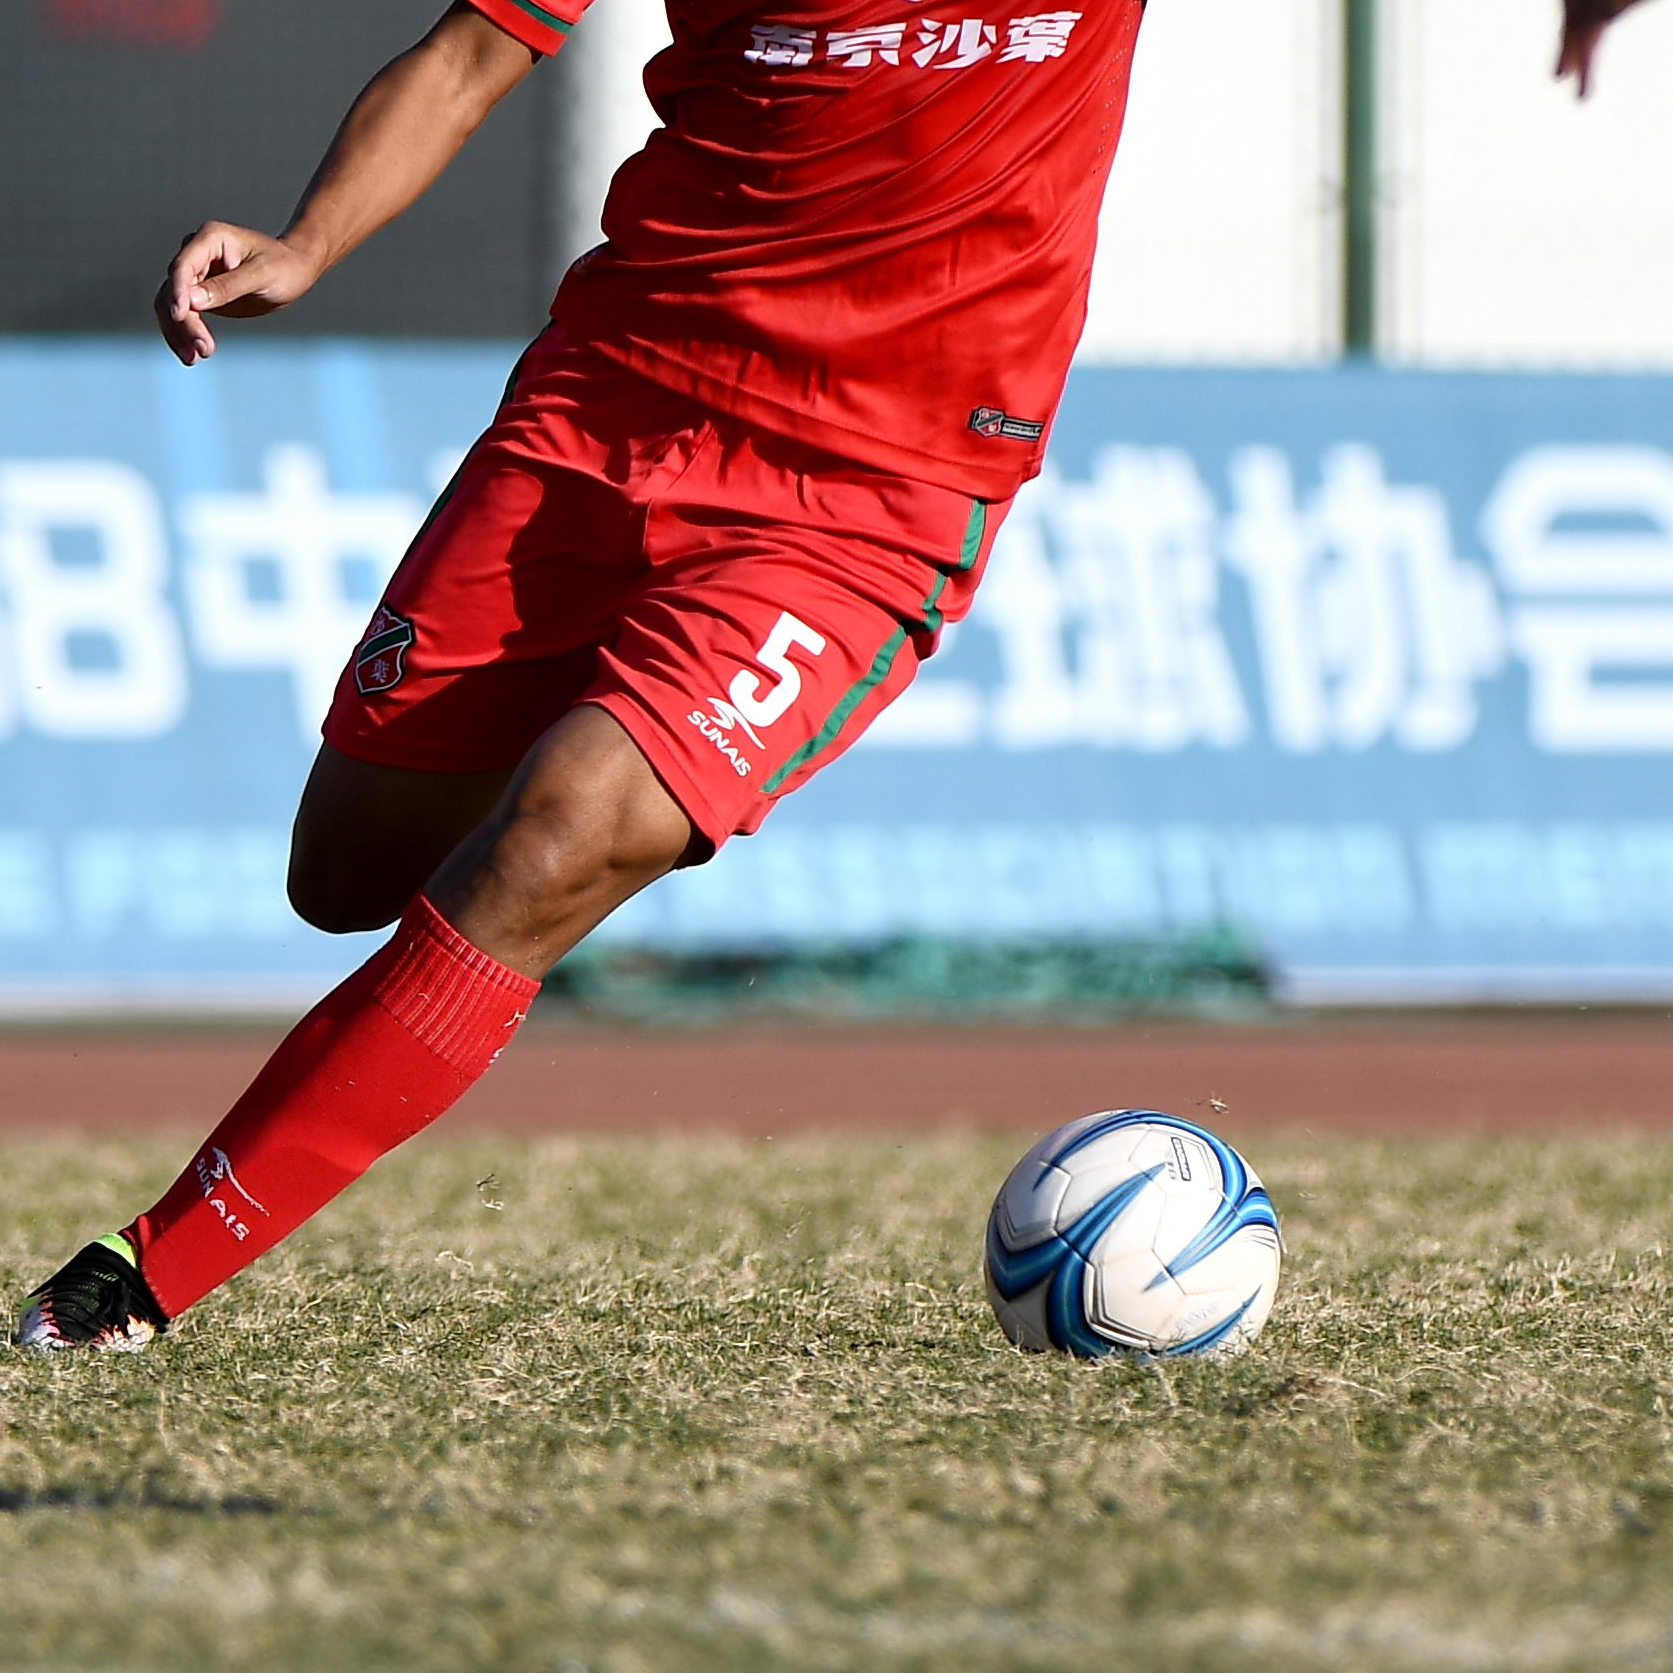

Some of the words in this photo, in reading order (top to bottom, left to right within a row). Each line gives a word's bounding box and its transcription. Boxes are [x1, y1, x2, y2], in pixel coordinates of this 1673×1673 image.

[729, 612, 826, 727] 5
[687, 710, 752, 776] SUNAIS
[196, 1157, 250, 1241] SUNAIS
